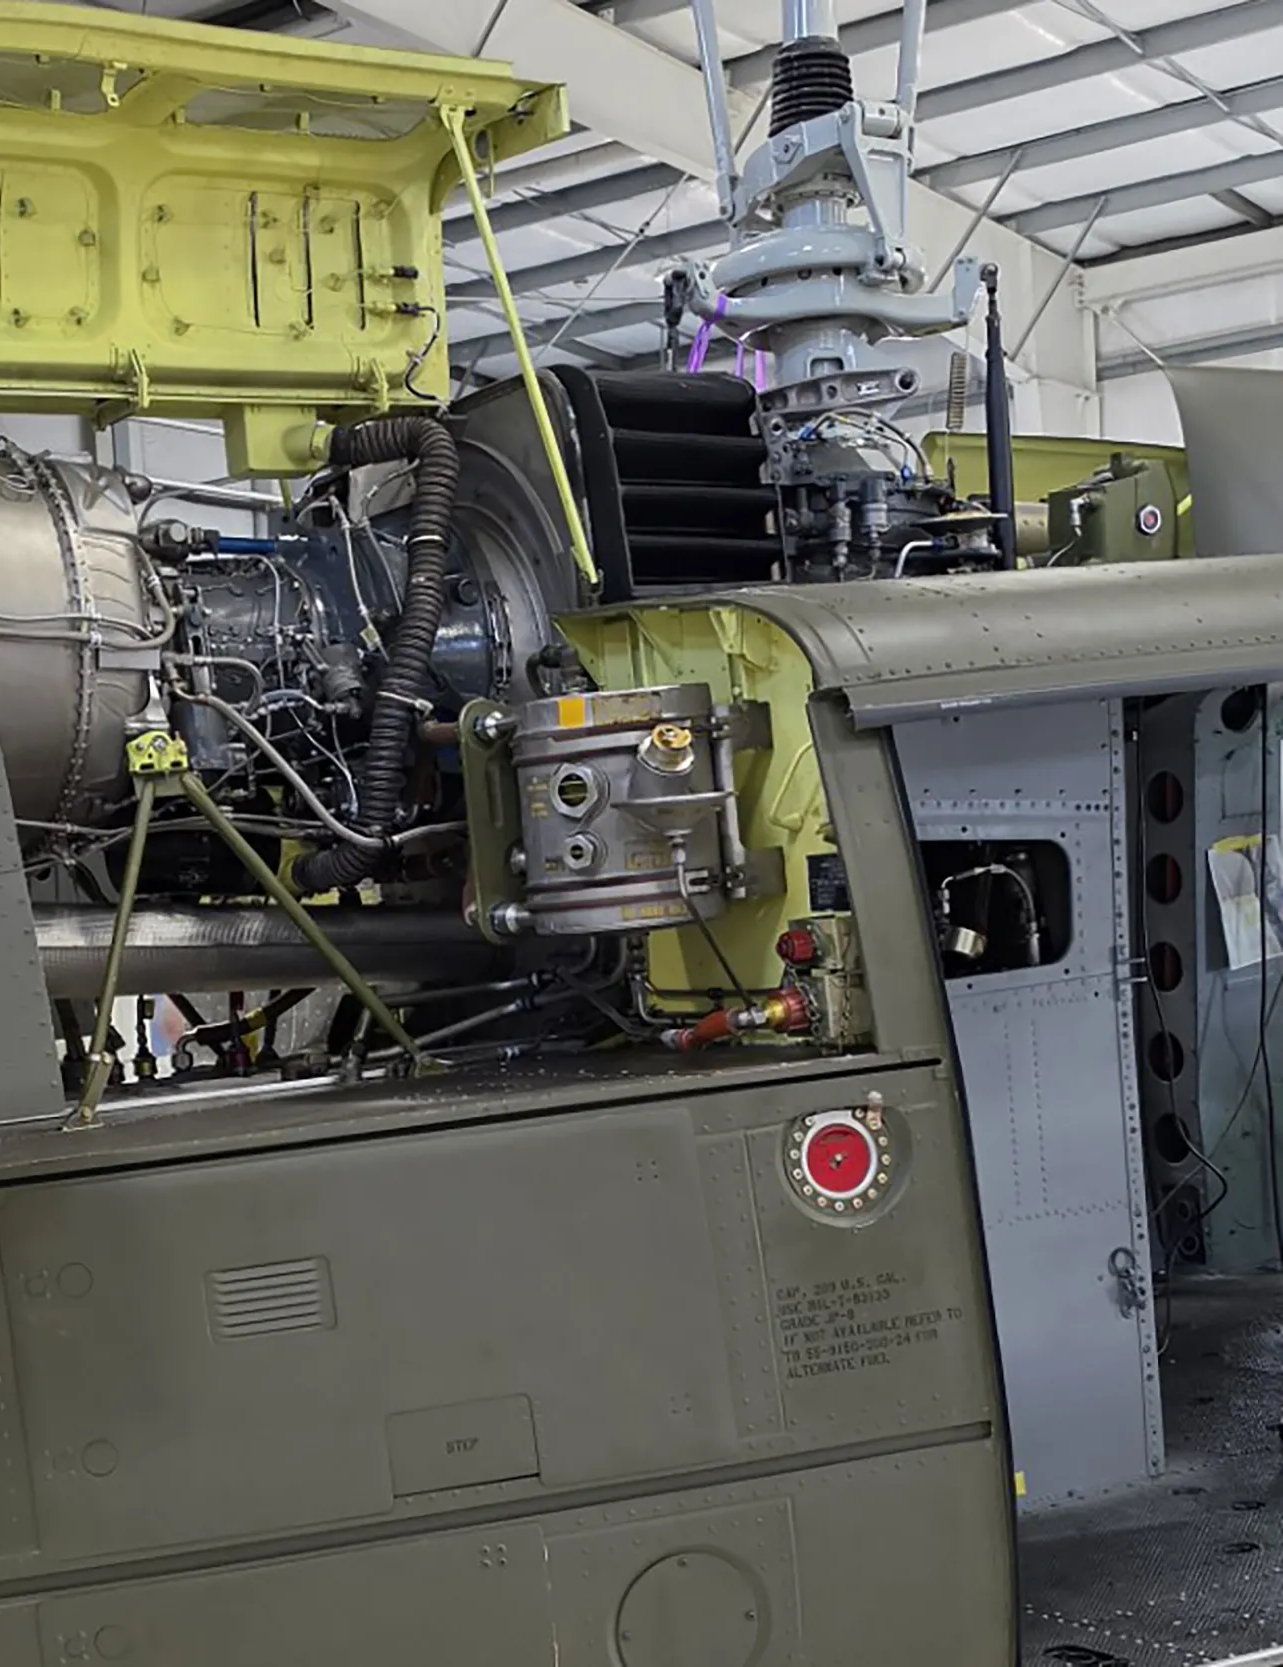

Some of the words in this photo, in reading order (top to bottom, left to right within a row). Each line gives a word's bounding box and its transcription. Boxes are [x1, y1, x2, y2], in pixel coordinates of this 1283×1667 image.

[780, 1314, 821, 1330] GRADE
[783, 1331, 799, 1346] IF
[802, 1327, 827, 1345] NOT
[832, 1315, 901, 1338] AVAILABLE
[904, 1309, 942, 1328] REFER
[946, 1306, 963, 1320] TO
[786, 1356, 856, 1379] ALTERNATE
